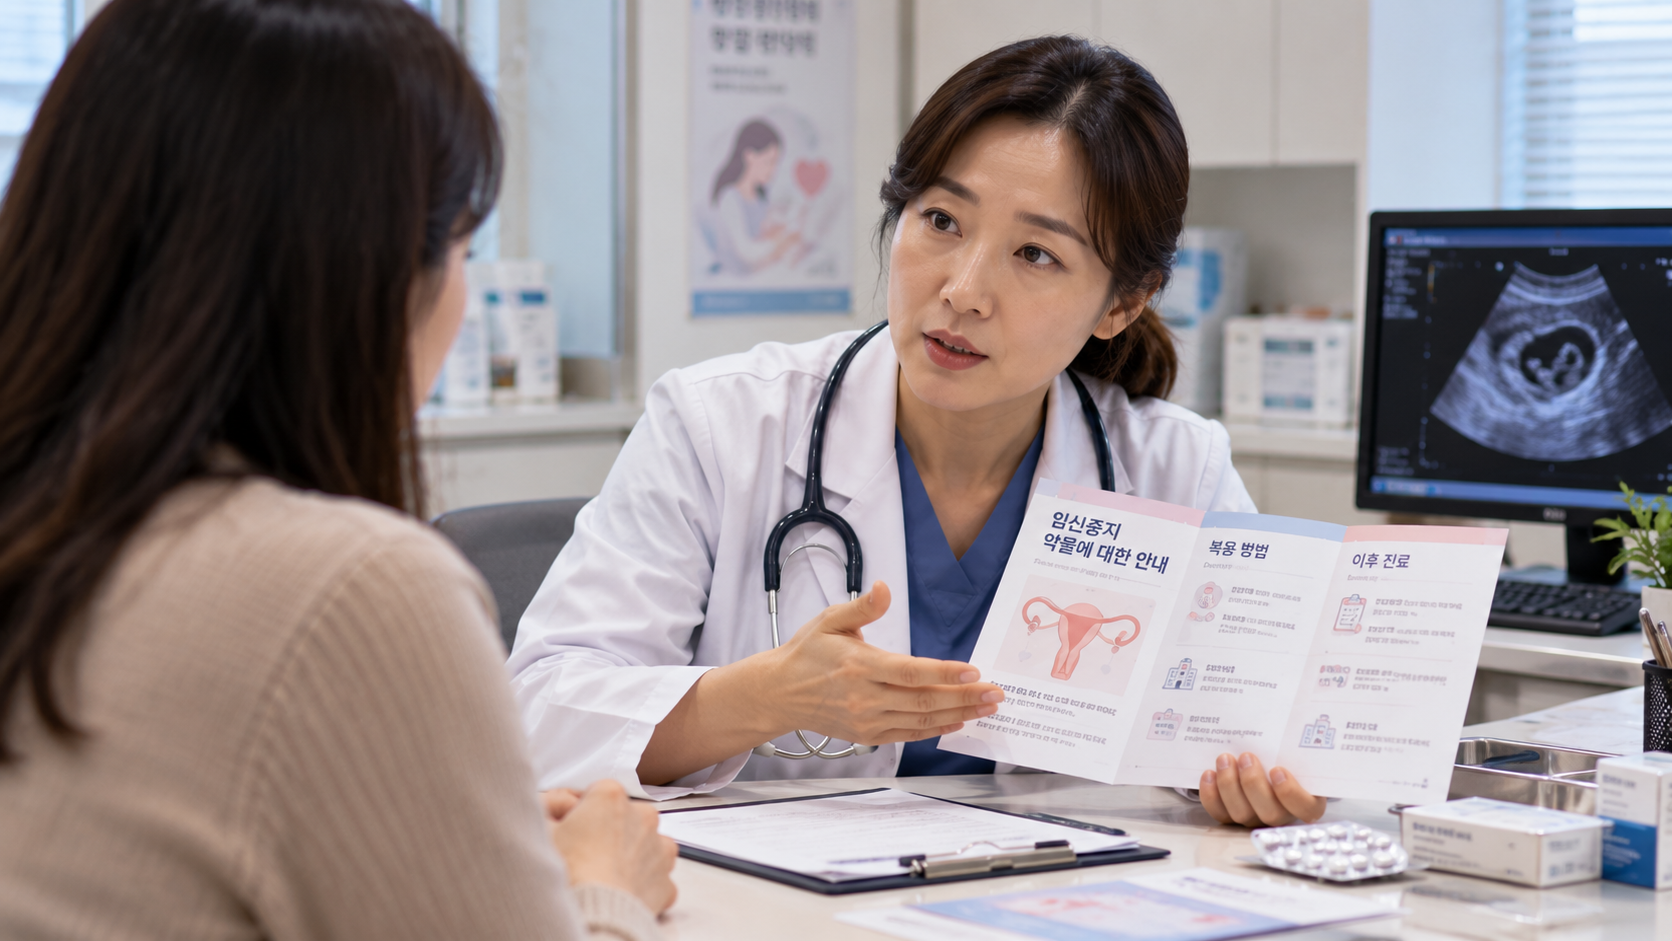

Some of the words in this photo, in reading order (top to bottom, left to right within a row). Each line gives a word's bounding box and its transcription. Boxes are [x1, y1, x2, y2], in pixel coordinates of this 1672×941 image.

[1052, 511, 1122, 541] 임신중지
[1096, 545, 1132, 567] 대한
[1135, 551, 1170, 575] 안내
[1208, 540, 1237, 557] 복용
[1353, 553, 1380, 569] 이후
[1384, 554, 1411, 569] 진료
